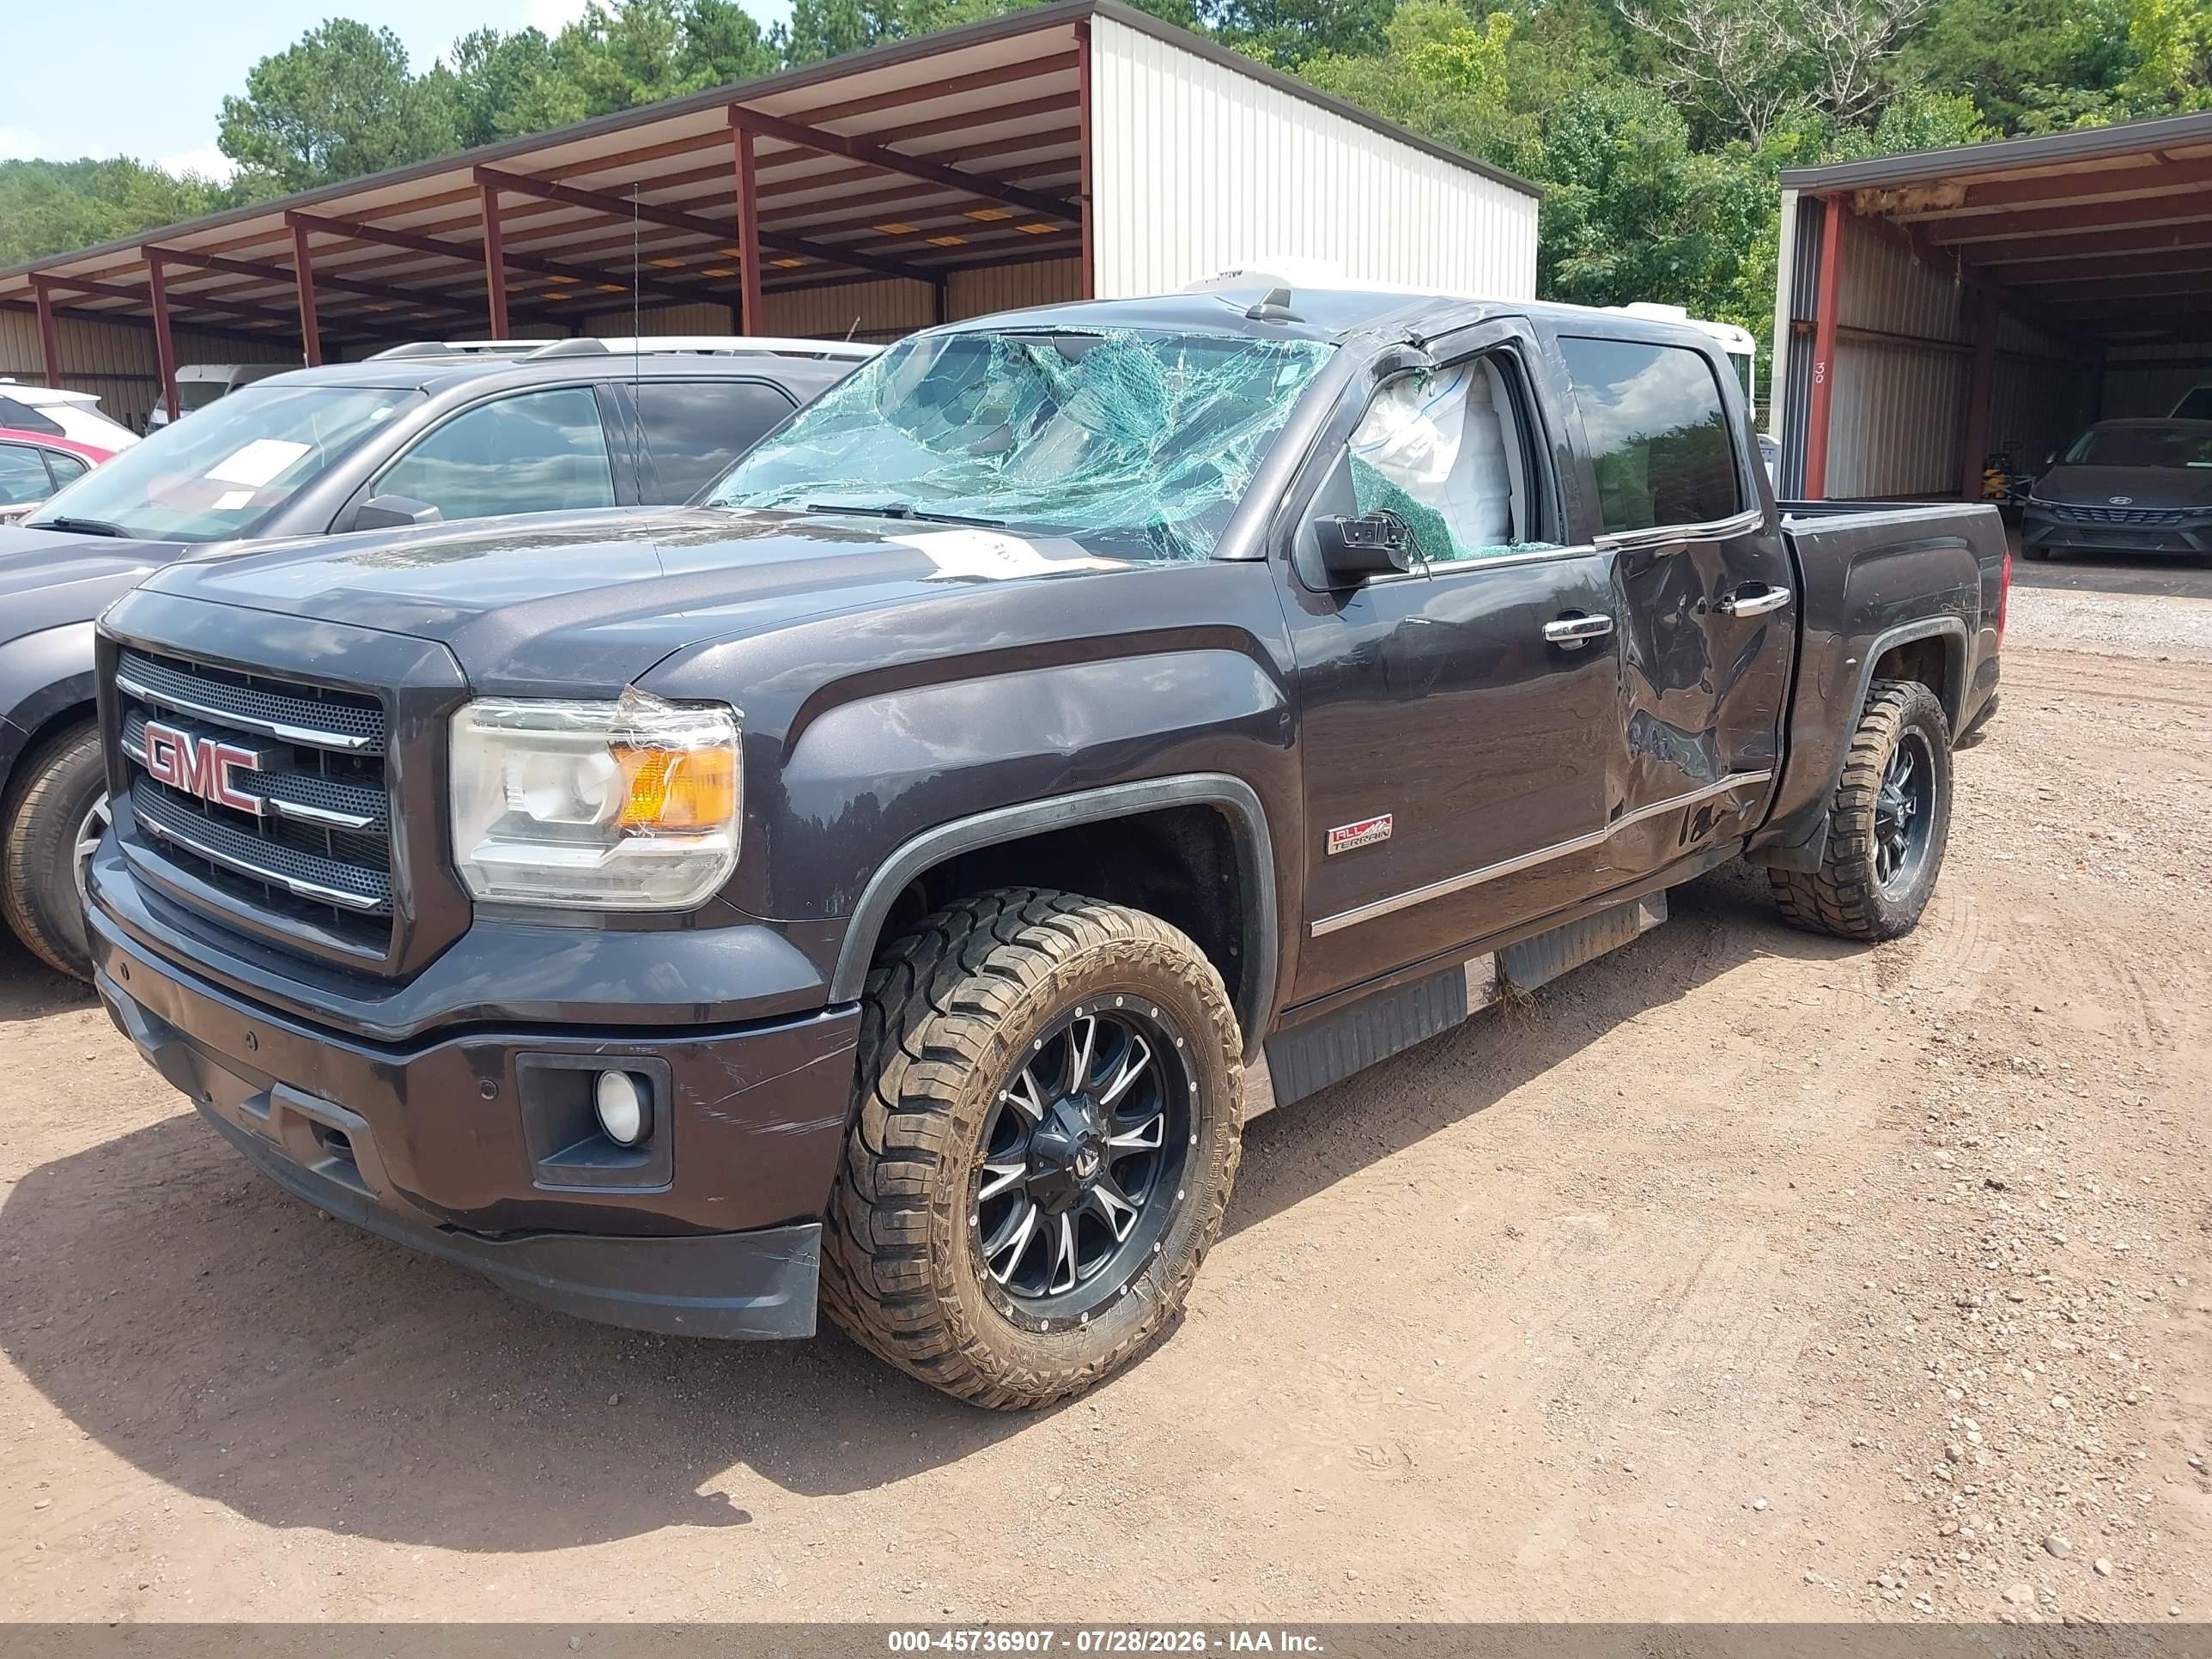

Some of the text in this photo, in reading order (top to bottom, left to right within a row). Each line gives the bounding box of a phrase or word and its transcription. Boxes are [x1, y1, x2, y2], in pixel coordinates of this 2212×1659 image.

[1814, 362, 1826, 384] 30
[145, 720, 265, 816] GMC
[1332, 829, 1390, 850] TERRAIN
[1336, 826, 1363, 841] ALL
